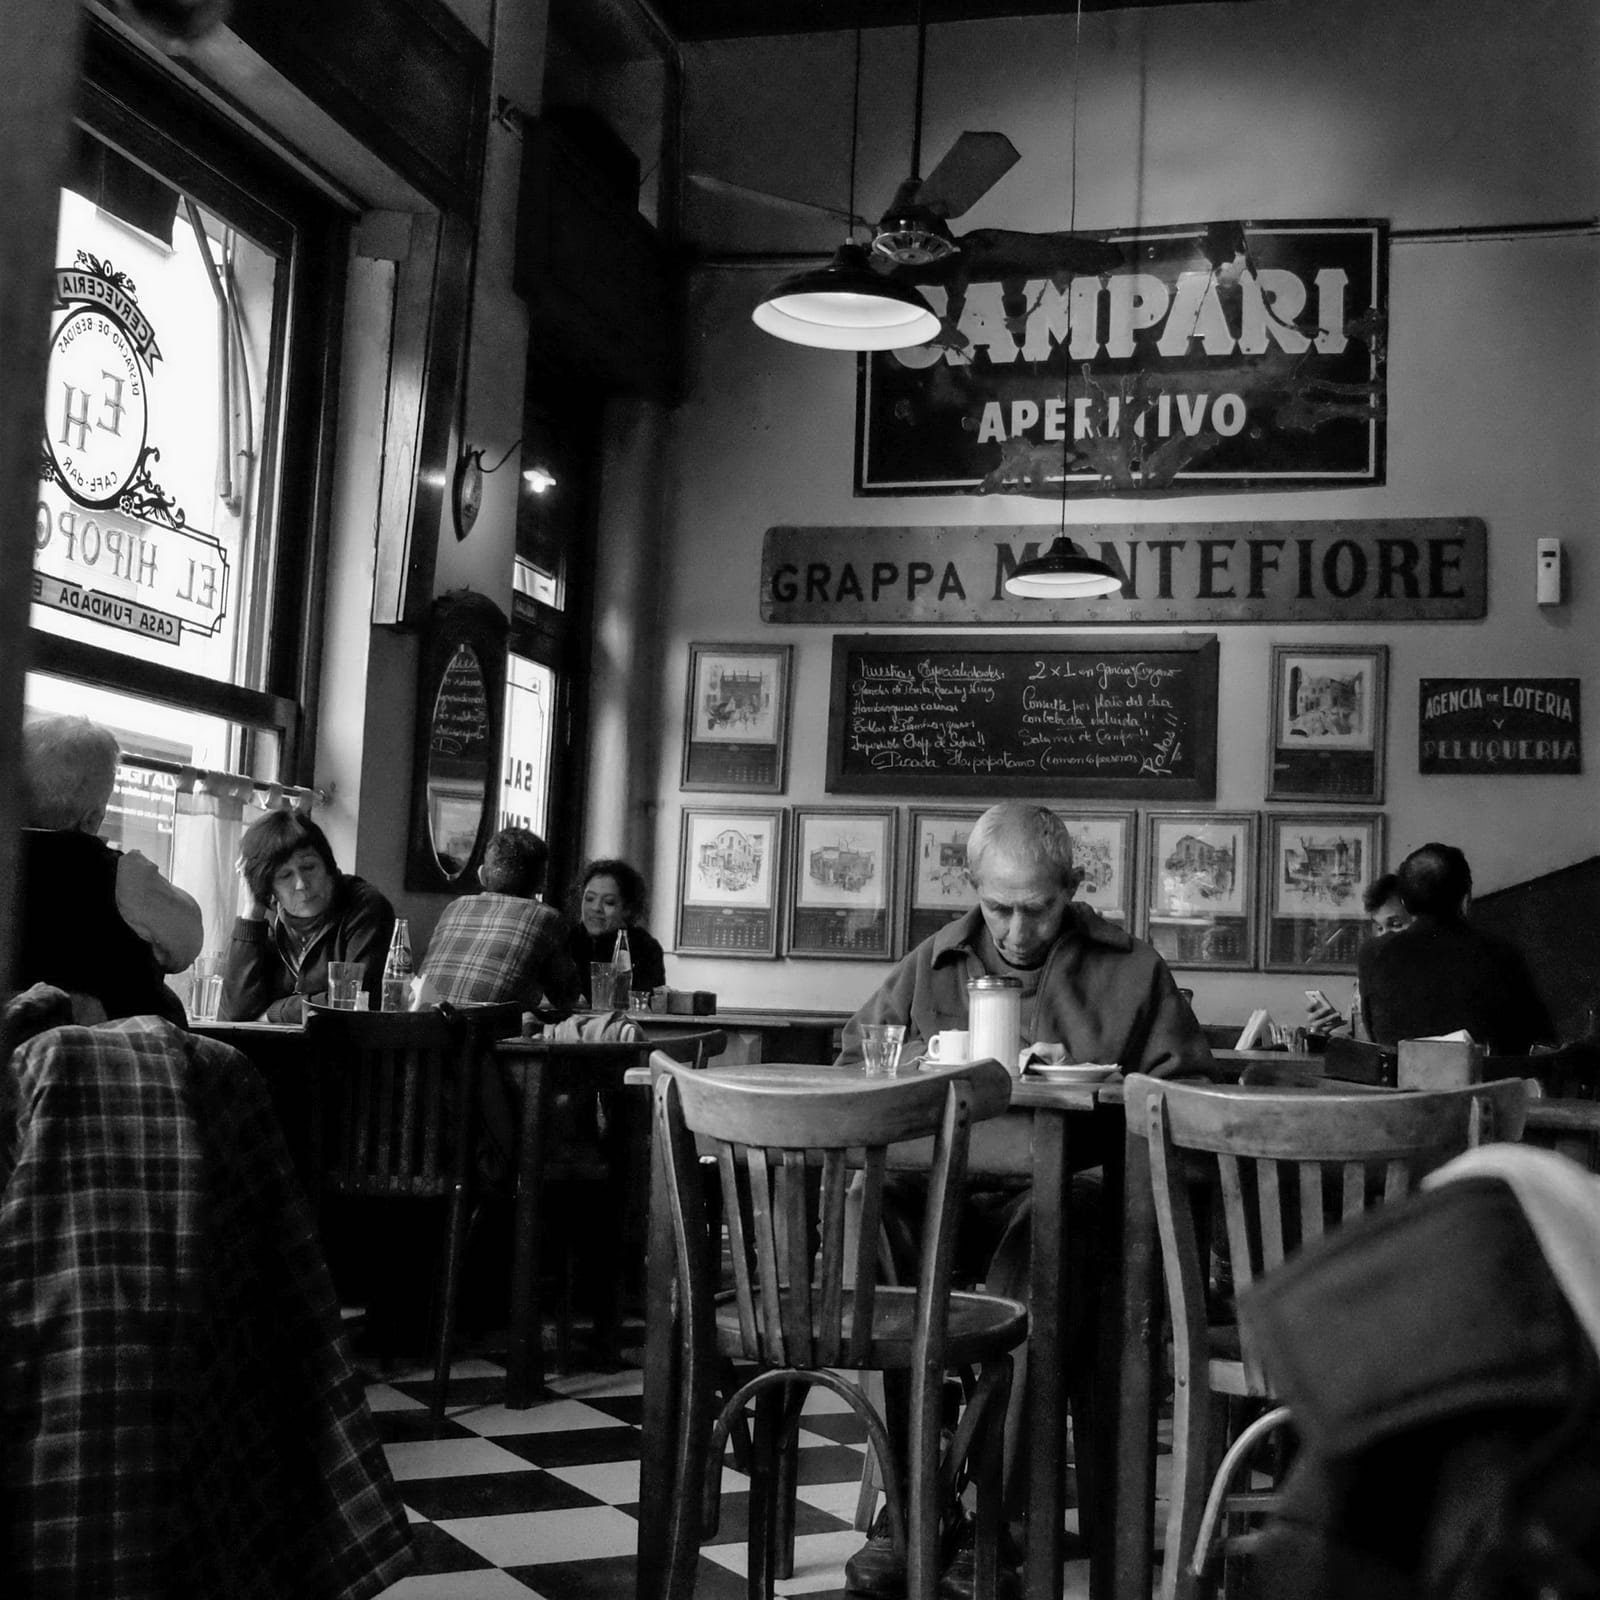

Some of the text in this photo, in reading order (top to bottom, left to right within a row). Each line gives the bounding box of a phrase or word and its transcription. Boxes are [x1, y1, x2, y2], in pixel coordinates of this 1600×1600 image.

[771, 538, 1467, 602] GRAPPA MNTEFIORE
[1425, 685, 1573, 723] AGENCIA DE LOTERIA
[1424, 739, 1578, 764] PELUQUERIA
